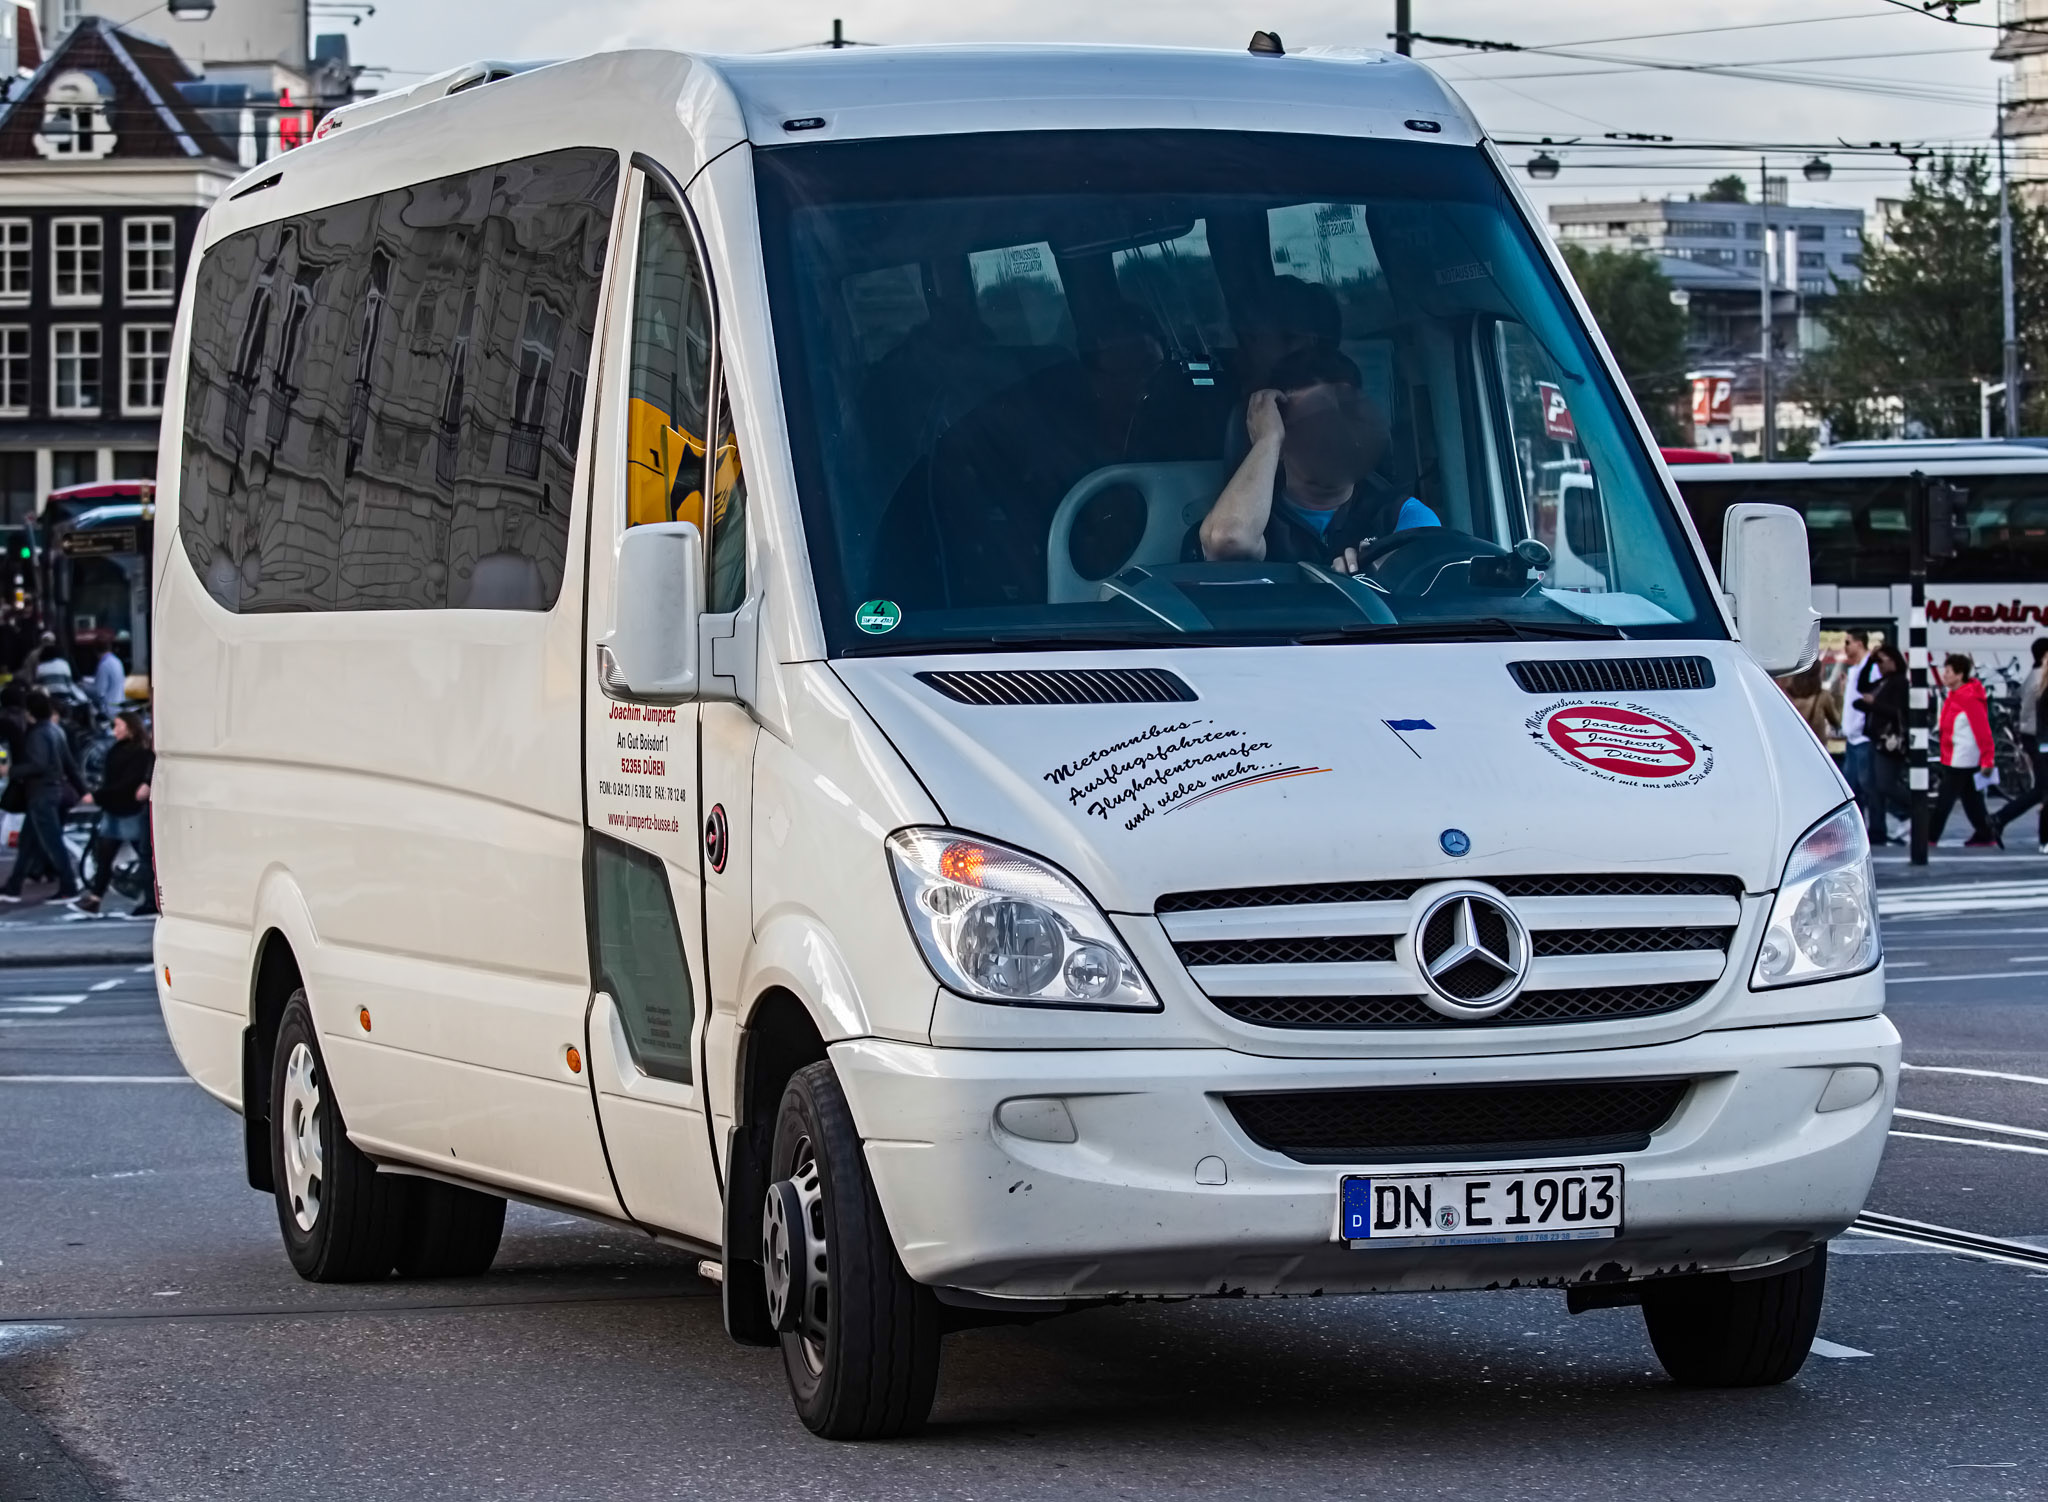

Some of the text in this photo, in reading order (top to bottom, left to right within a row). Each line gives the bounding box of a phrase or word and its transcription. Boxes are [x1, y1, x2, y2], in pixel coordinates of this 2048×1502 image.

[873, 601, 885, 616] 4
[1949, 626, 2036, 635] DUIVENDRECHT
[609, 701, 676, 727] Joachim Jumpertz
[1582, 718, 1650, 734] Joachim
[617, 732, 669, 752] An Gut Boisdorf 1
[1588, 732, 1666, 750] Jumpertz
[621, 755, 665, 776] 52355 DÜREN
[1603, 749, 1663, 764] Düren
[599, 780, 612, 795] FON:
[1087, 741, 1273, 820] Flughafentransfer
[1663, 780, 1690, 789] wohin
[1688, 774, 1706, 785] Sie
[1124, 802, 1155, 830] und
[1157, 780, 1207, 808] vieles
[607, 811, 679, 833] www.jumpertz-busse.de
[1373, 1175, 1614, 1230] DN E 1903
[1352, 1215, 1362, 1227] D
